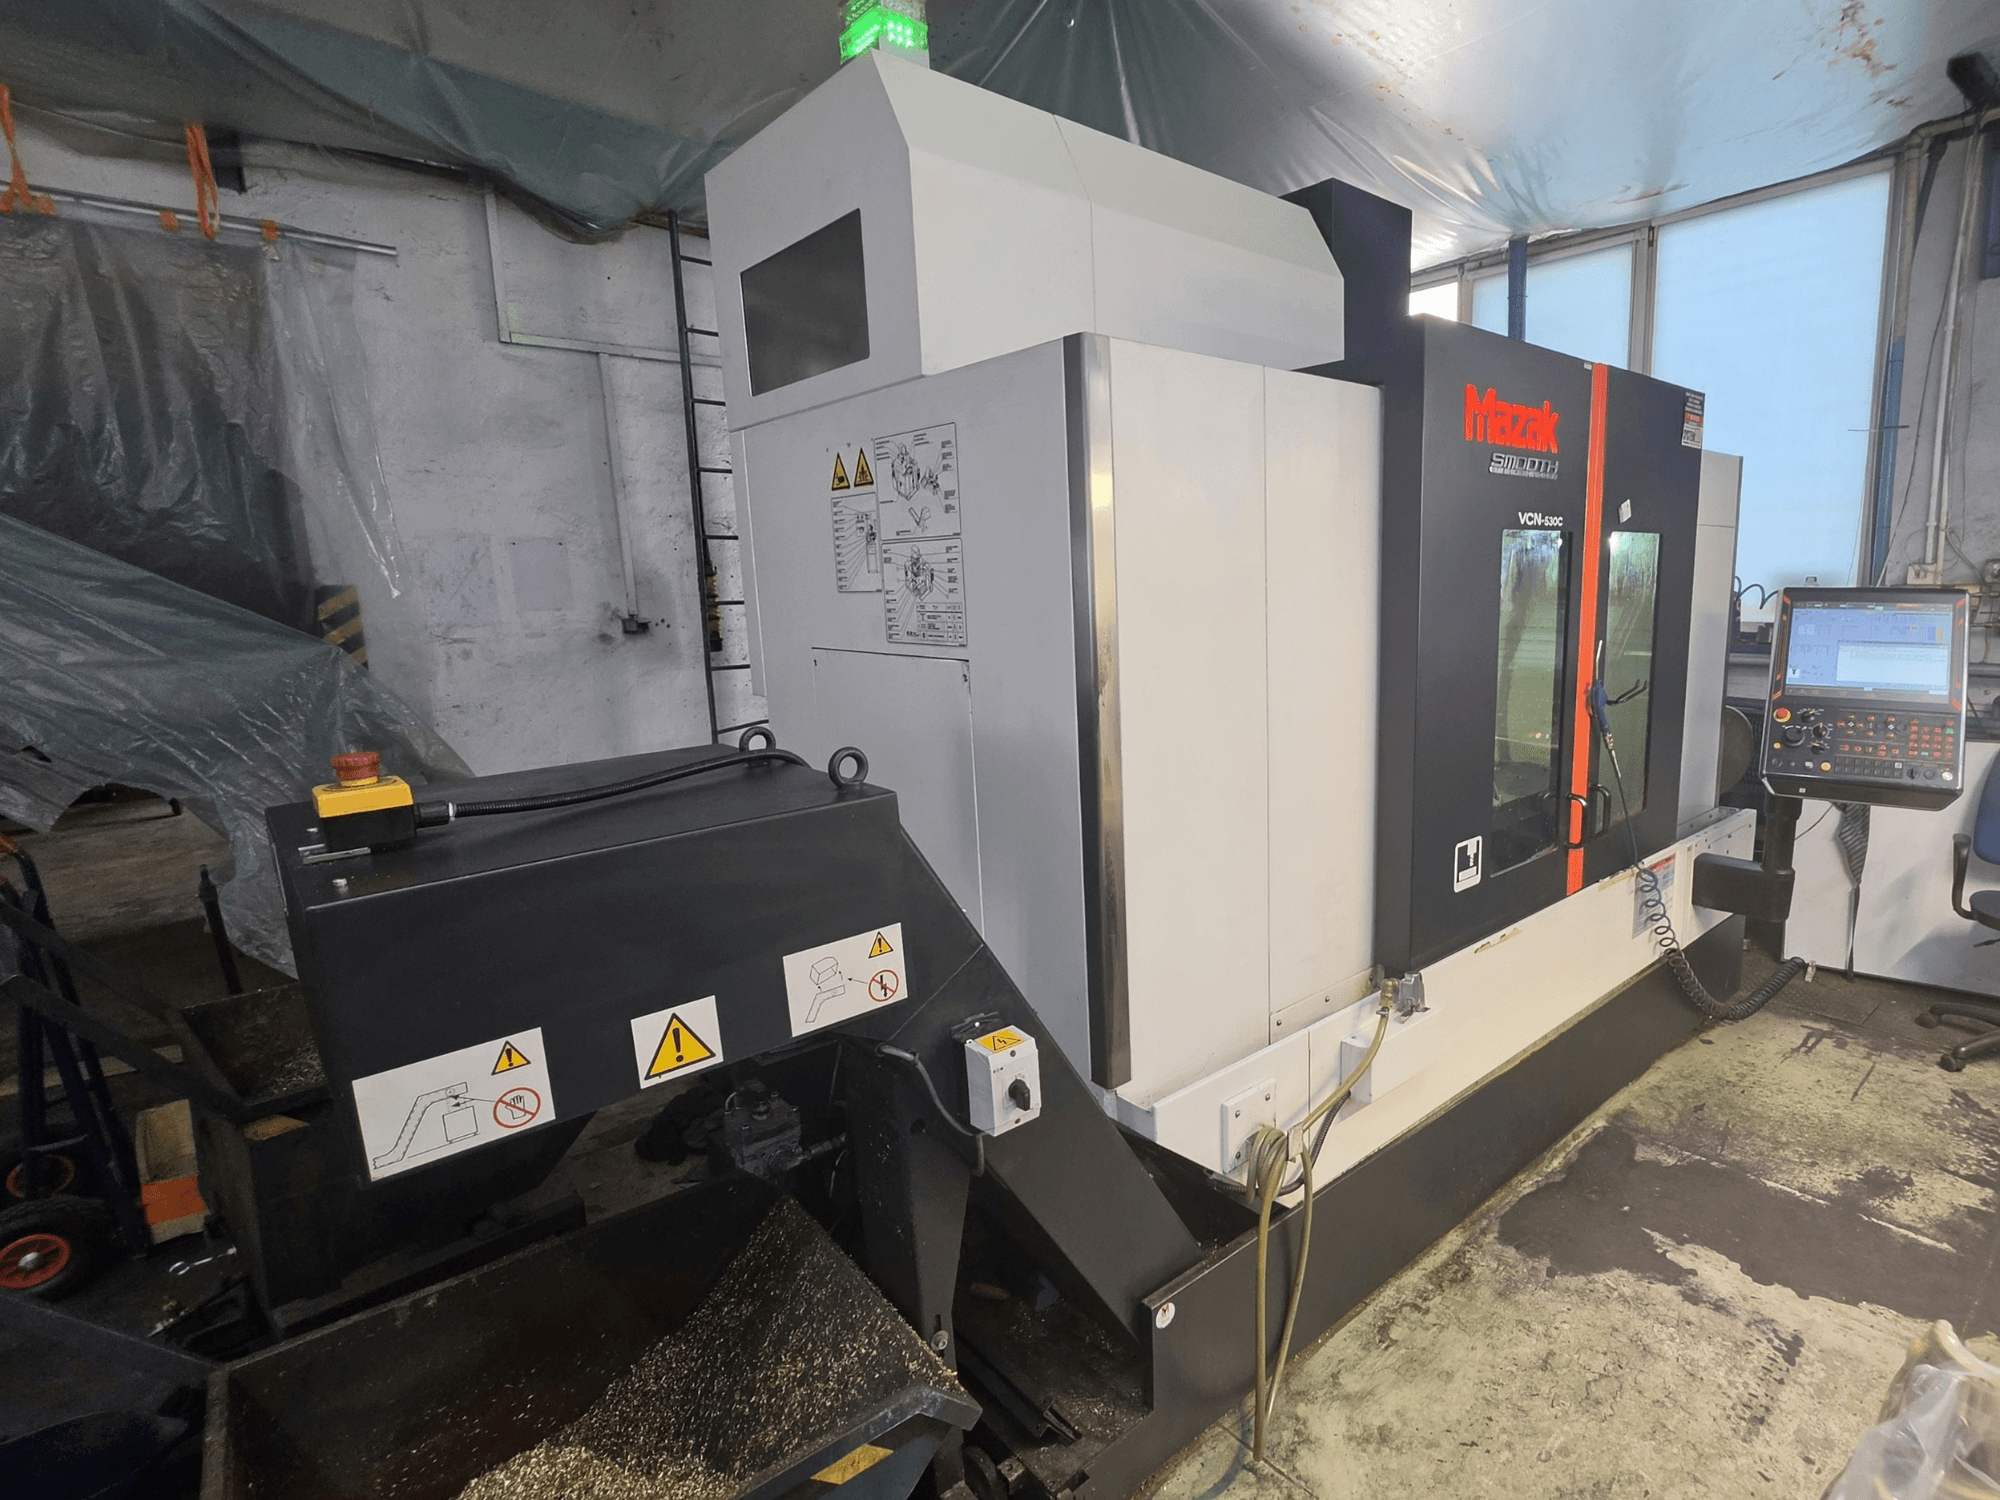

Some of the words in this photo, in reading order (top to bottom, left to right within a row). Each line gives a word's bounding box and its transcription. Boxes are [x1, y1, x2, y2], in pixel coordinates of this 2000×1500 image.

[1465, 383, 1559, 453] Mazak
[1491, 453, 1559, 474] SMOOTH
[1518, 511, 1563, 527] VCN-530C
